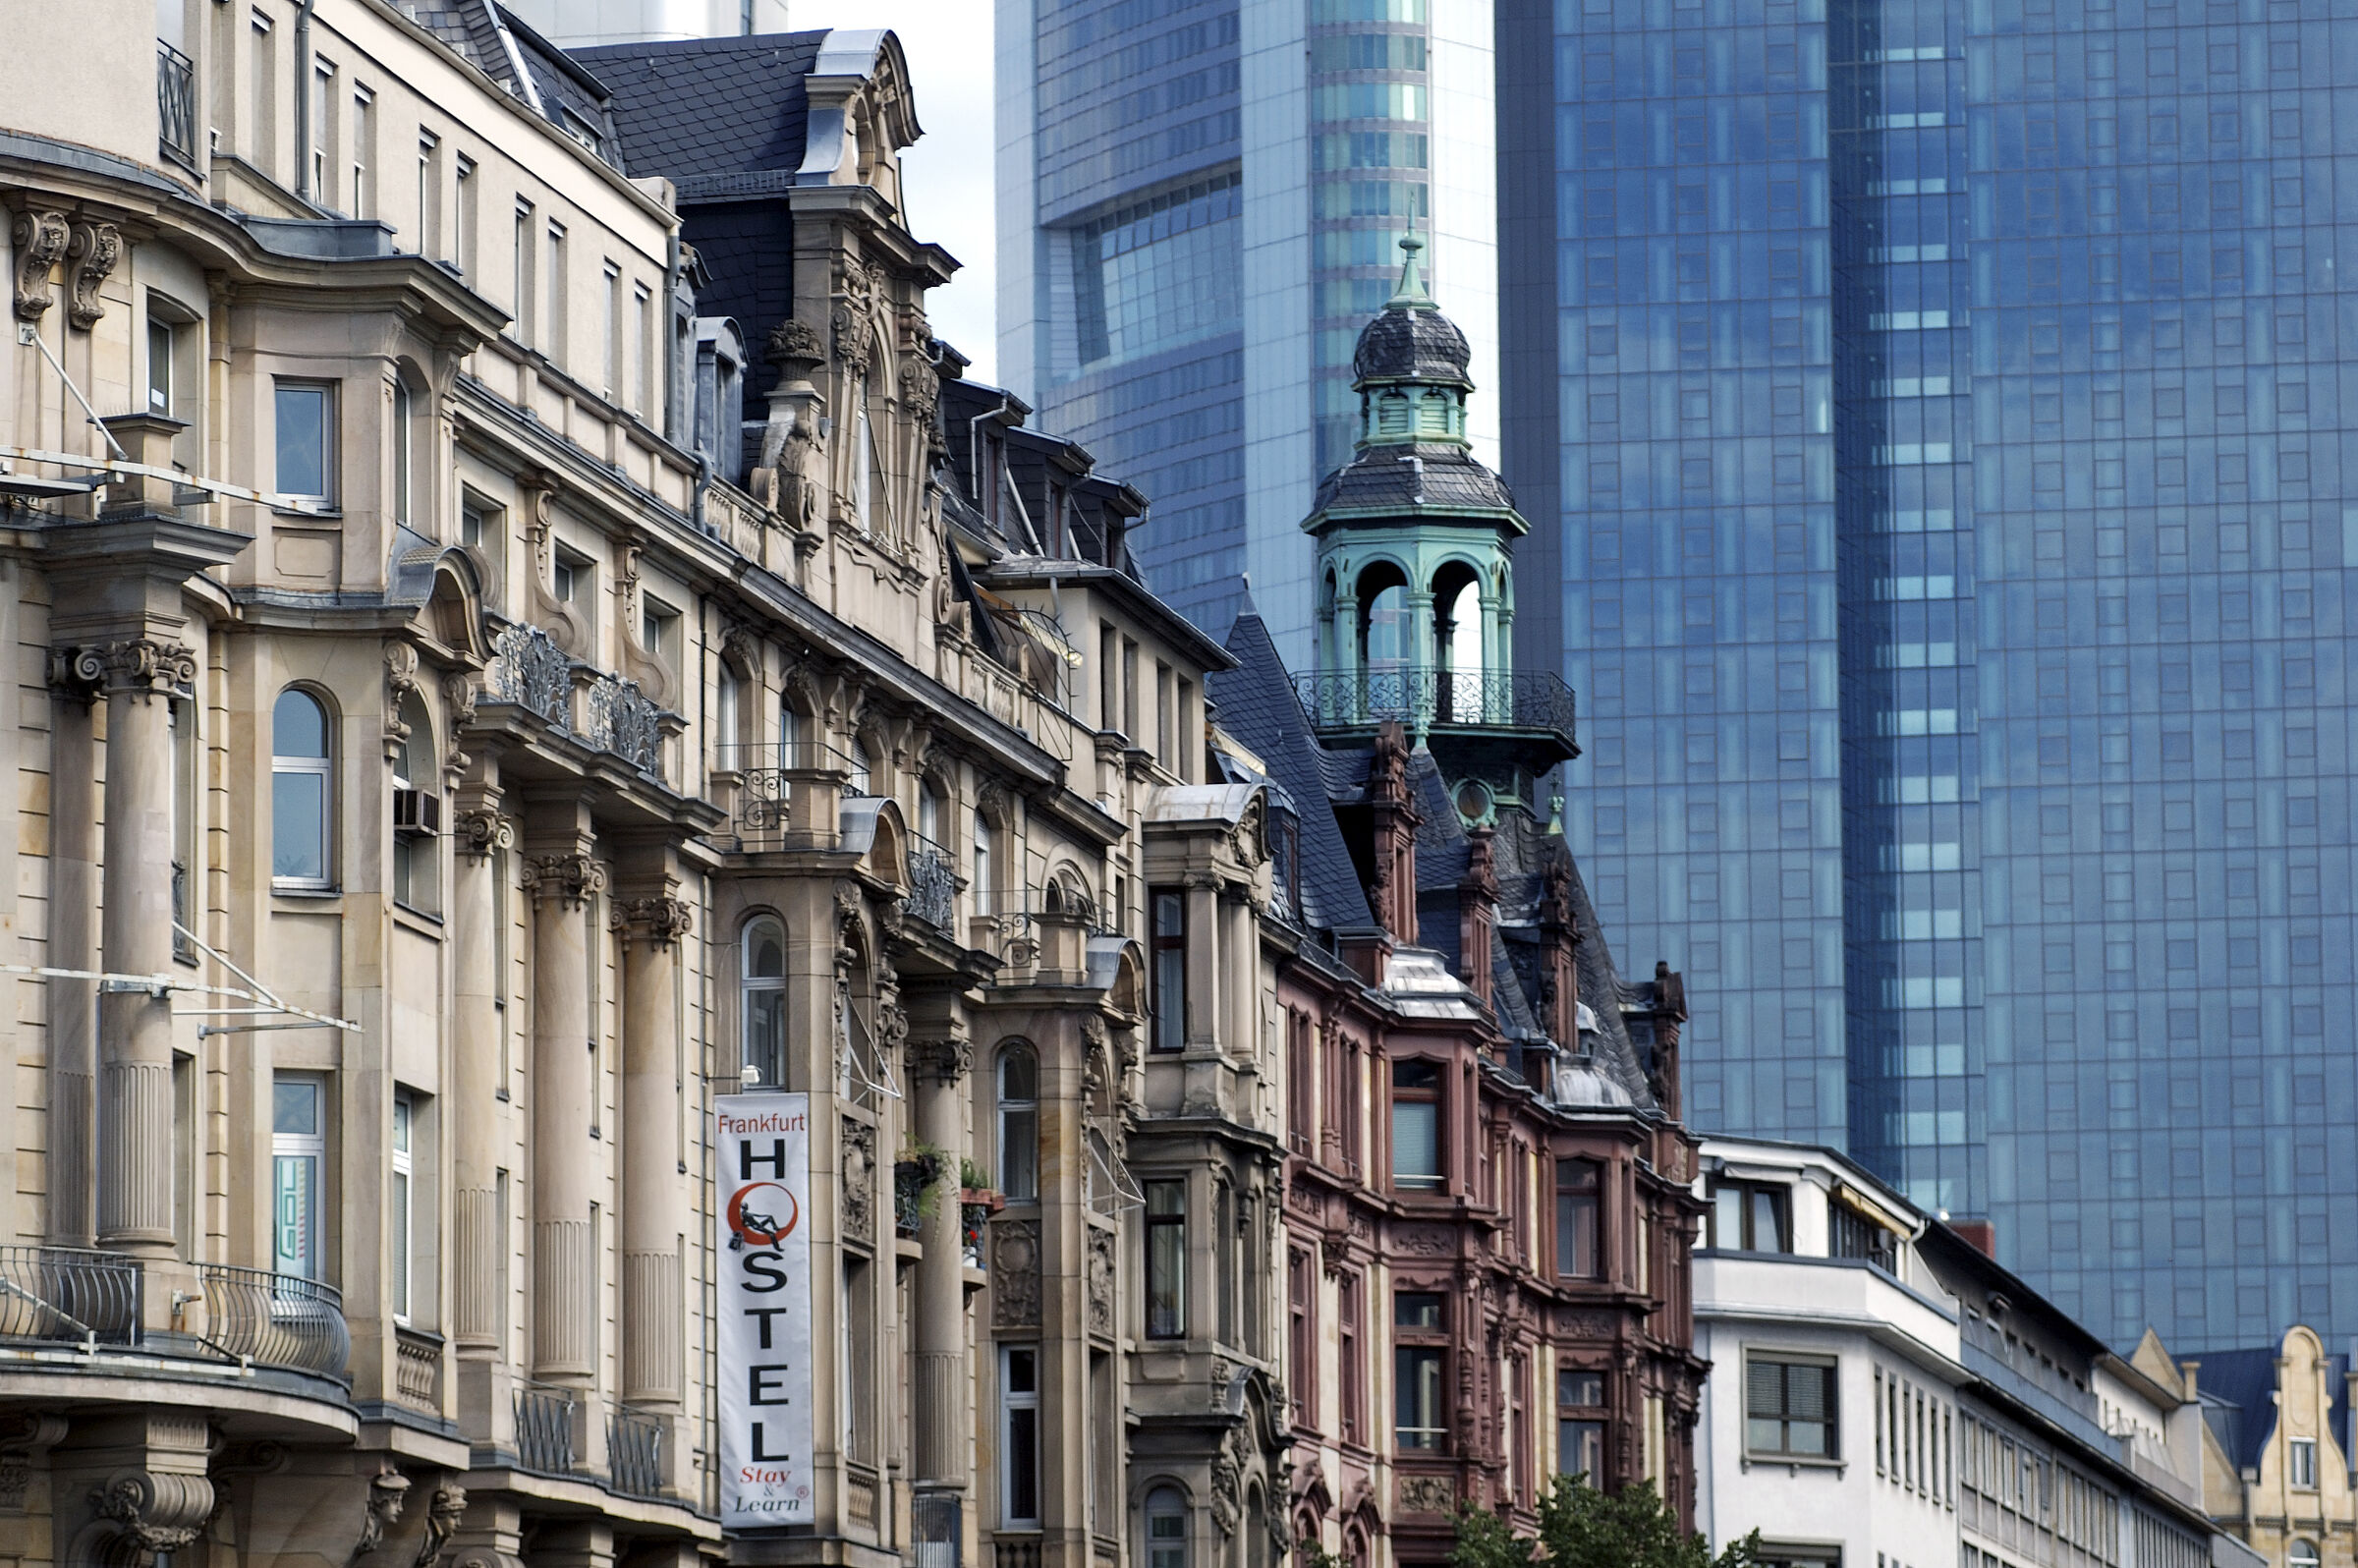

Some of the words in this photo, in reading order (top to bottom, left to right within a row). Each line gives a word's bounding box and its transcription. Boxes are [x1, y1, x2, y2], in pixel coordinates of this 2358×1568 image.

[718, 1113, 805, 1134] Frankfurt
[727, 1139, 798, 1462] HOSTEL
[740, 1466, 791, 1487] Stay
[763, 1483, 774, 1496] &
[735, 1495, 800, 1513] Learn
